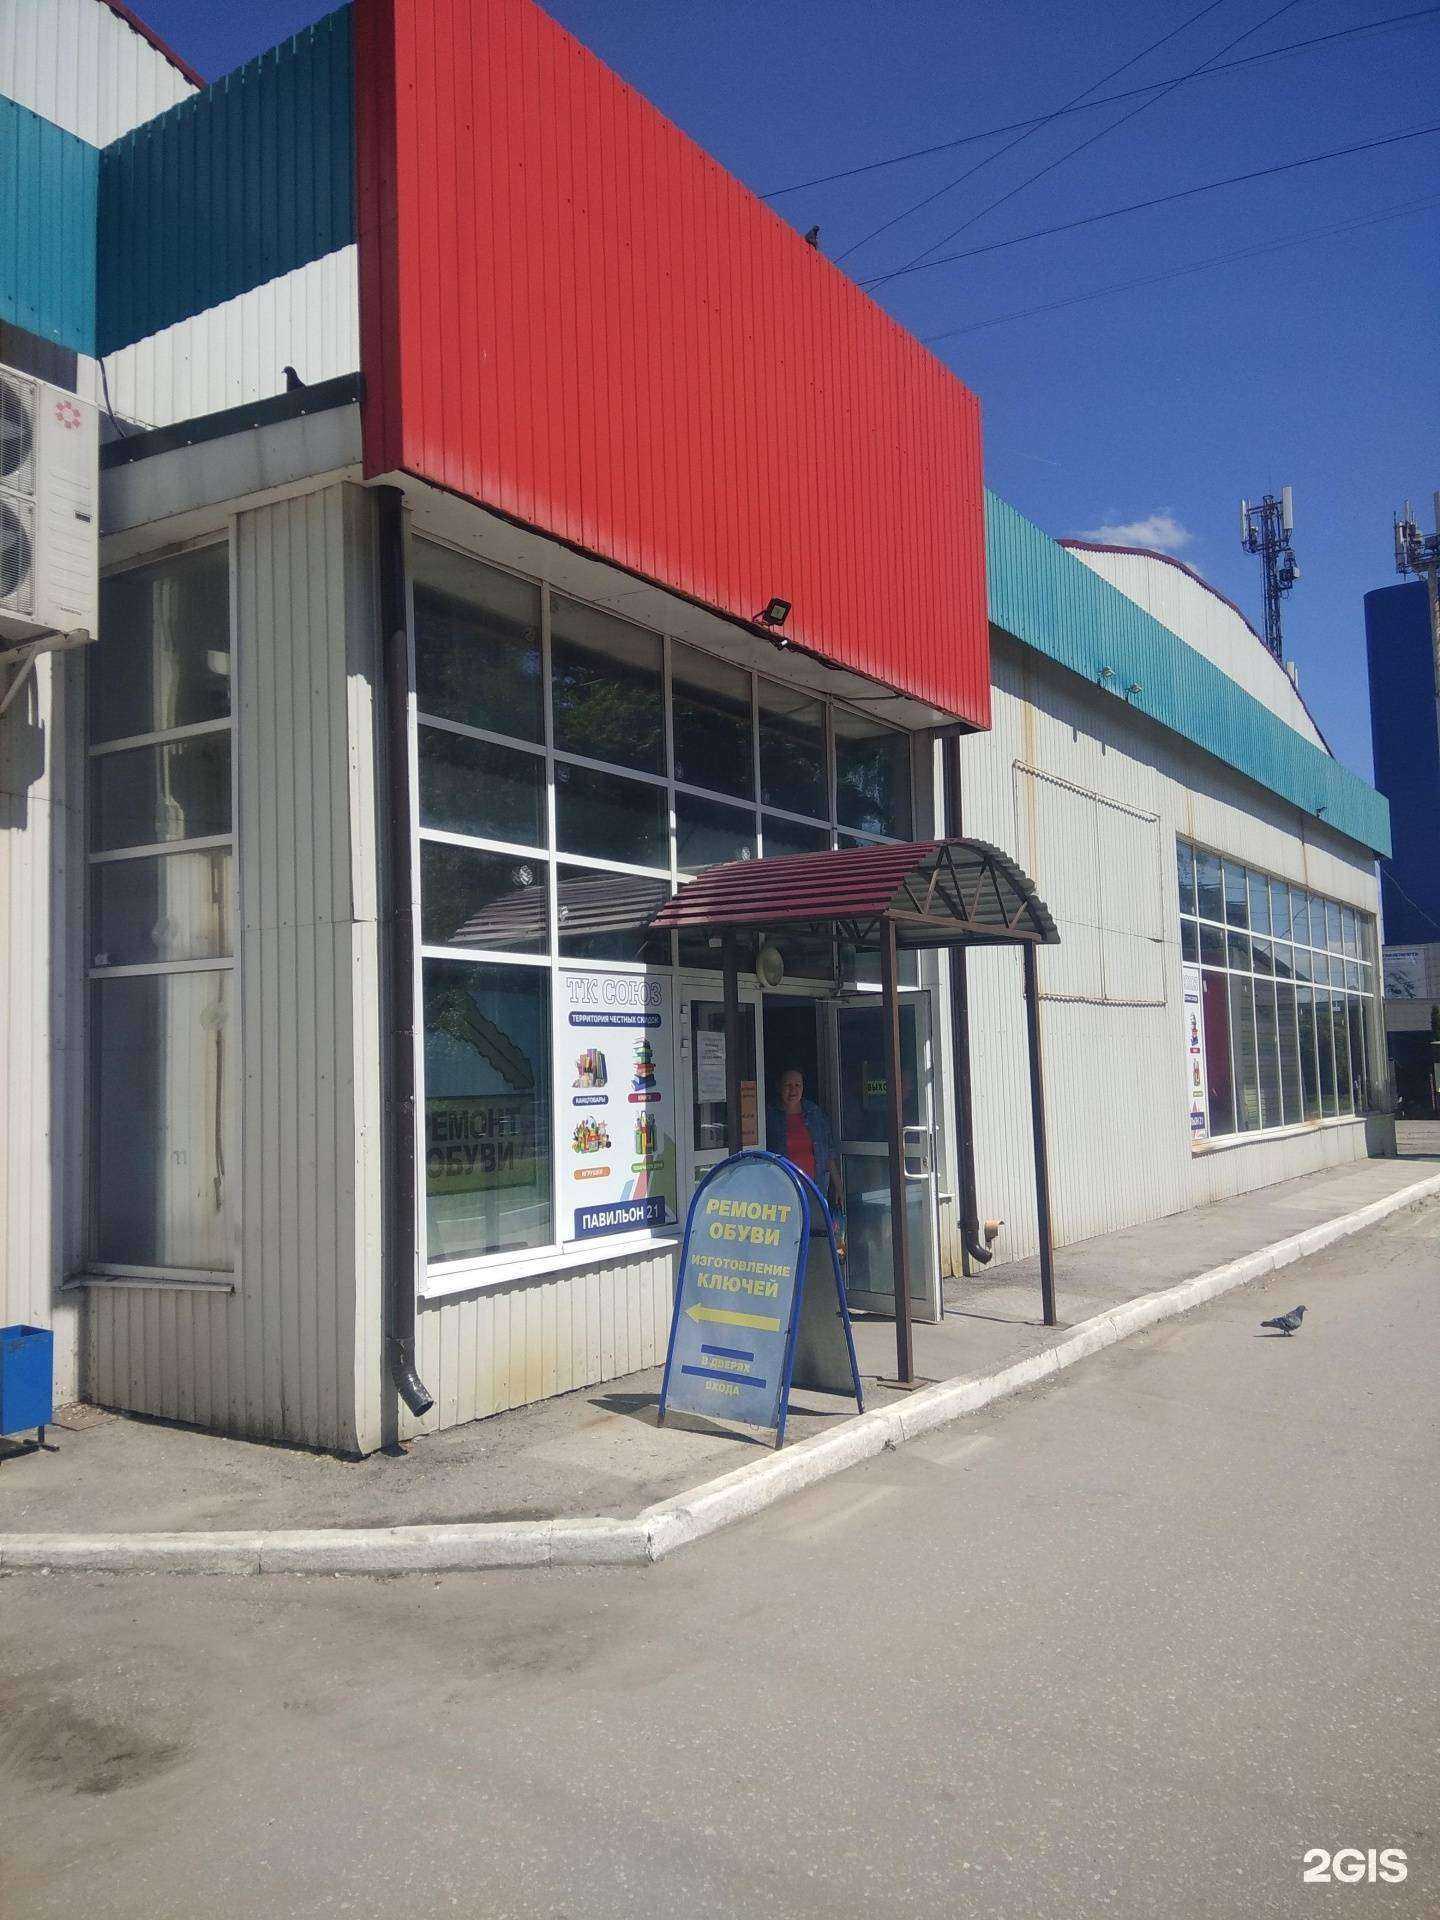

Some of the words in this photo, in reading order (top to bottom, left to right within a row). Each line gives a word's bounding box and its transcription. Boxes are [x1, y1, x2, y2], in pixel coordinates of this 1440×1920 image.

[566, 977, 598, 1003] ТК
[602, 979, 662, 1006] СОЮЗ
[572, 1014, 609, 1023] ТЕРРИТОРИЯ
[609, 1015, 636, 1023] ЧЕСТНЫХ
[426, 1142, 514, 1179] ОБУВИ
[582, 1206, 644, 1229] ПАВИЛЬОН
[646, 1204, 659, 1218] 21
[706, 1199, 791, 1222] РЕМОНТ
[709, 1222, 780, 1246] ОБУВИ
[692, 1255, 791, 1277] ИЗГОТОВЛЕНИЕ
[697, 1273, 779, 1298] КЛЮЧЕЙ
[701, 1356, 708, 1365] В
[710, 1358, 750, 1373] ДВЕРЯХ
